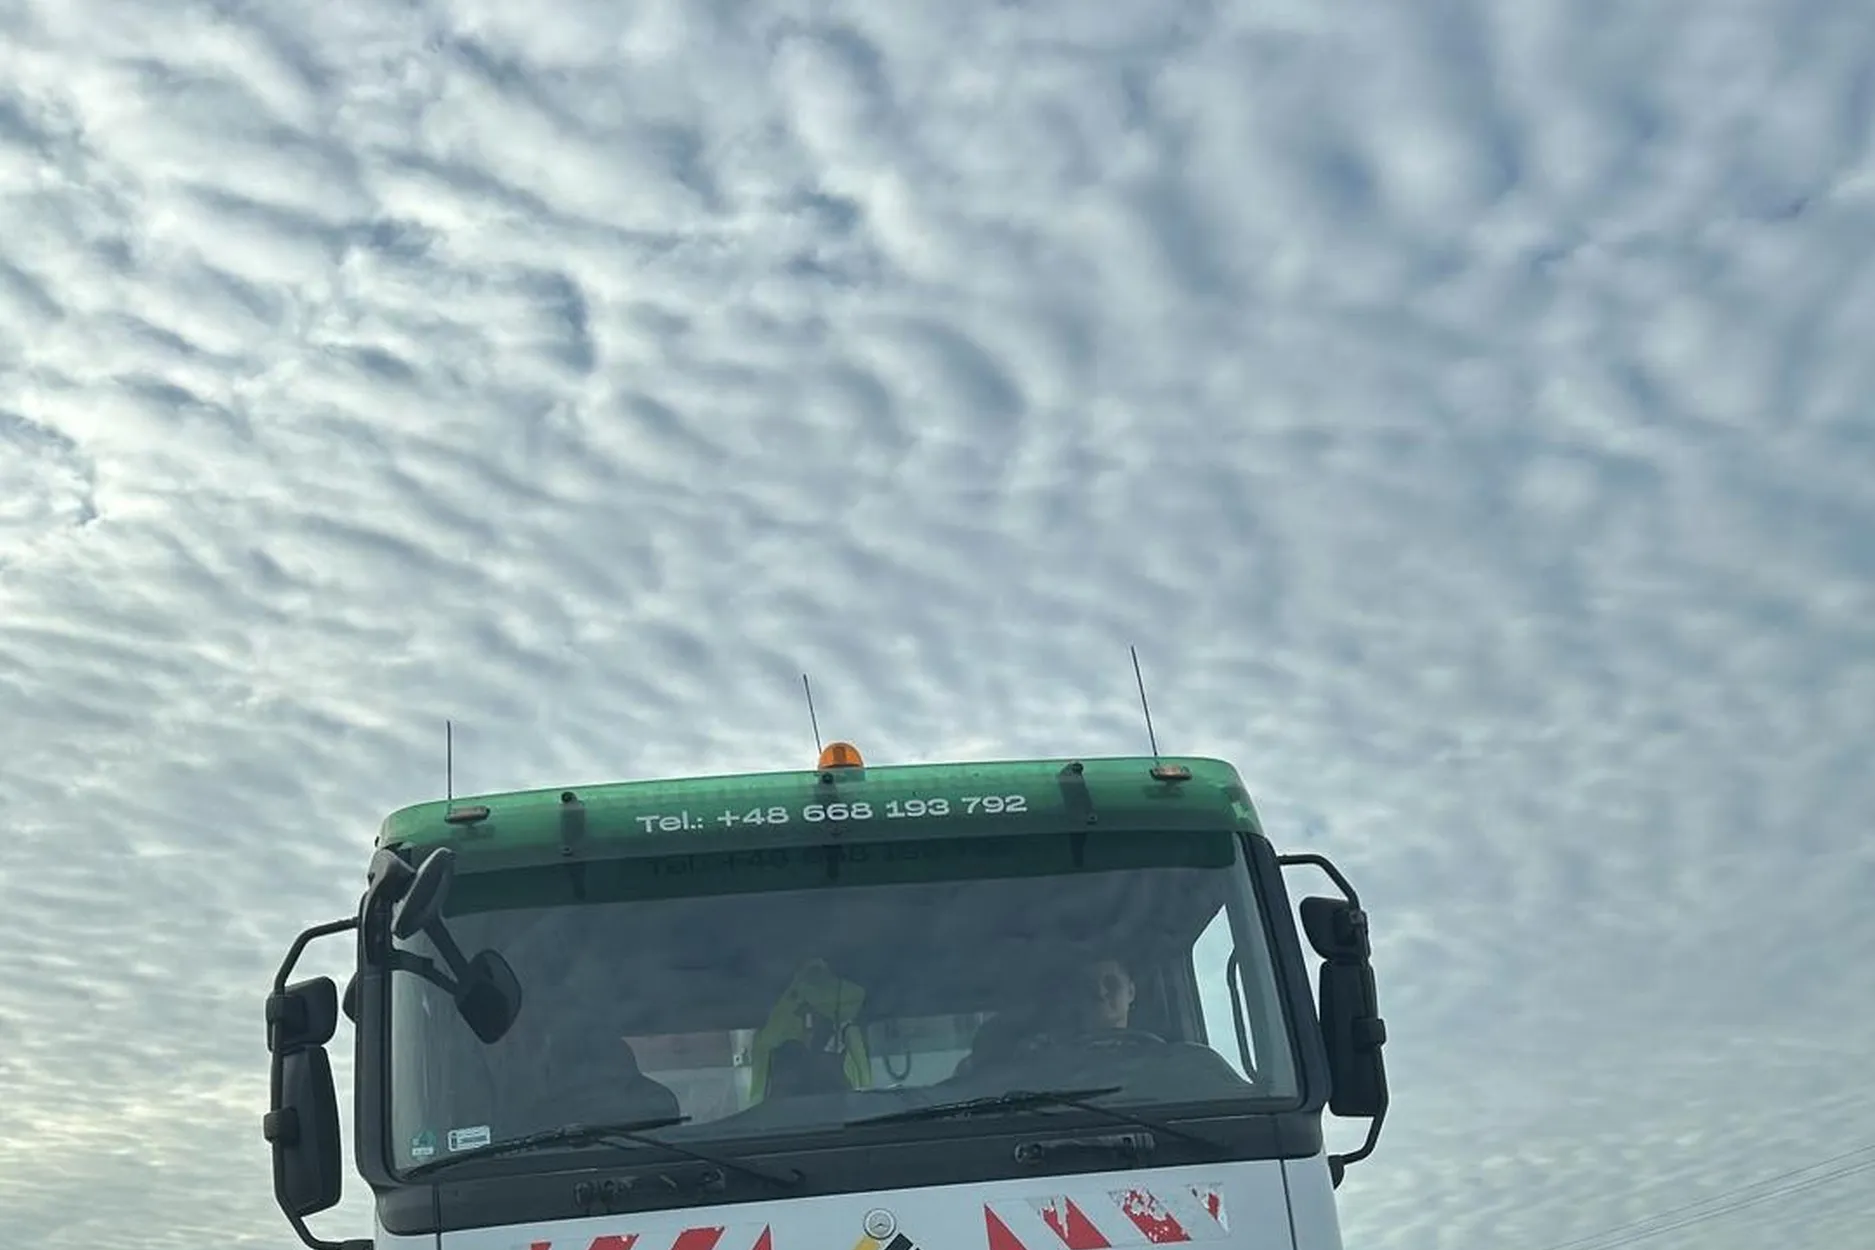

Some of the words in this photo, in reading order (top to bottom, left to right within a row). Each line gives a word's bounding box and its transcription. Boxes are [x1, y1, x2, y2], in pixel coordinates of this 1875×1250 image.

[635, 809, 704, 833] Tel.:
[716, 806, 790, 827] +48
[802, 802, 873, 822] 668
[885, 797, 951, 818] 193
[961, 795, 1028, 815] 792
